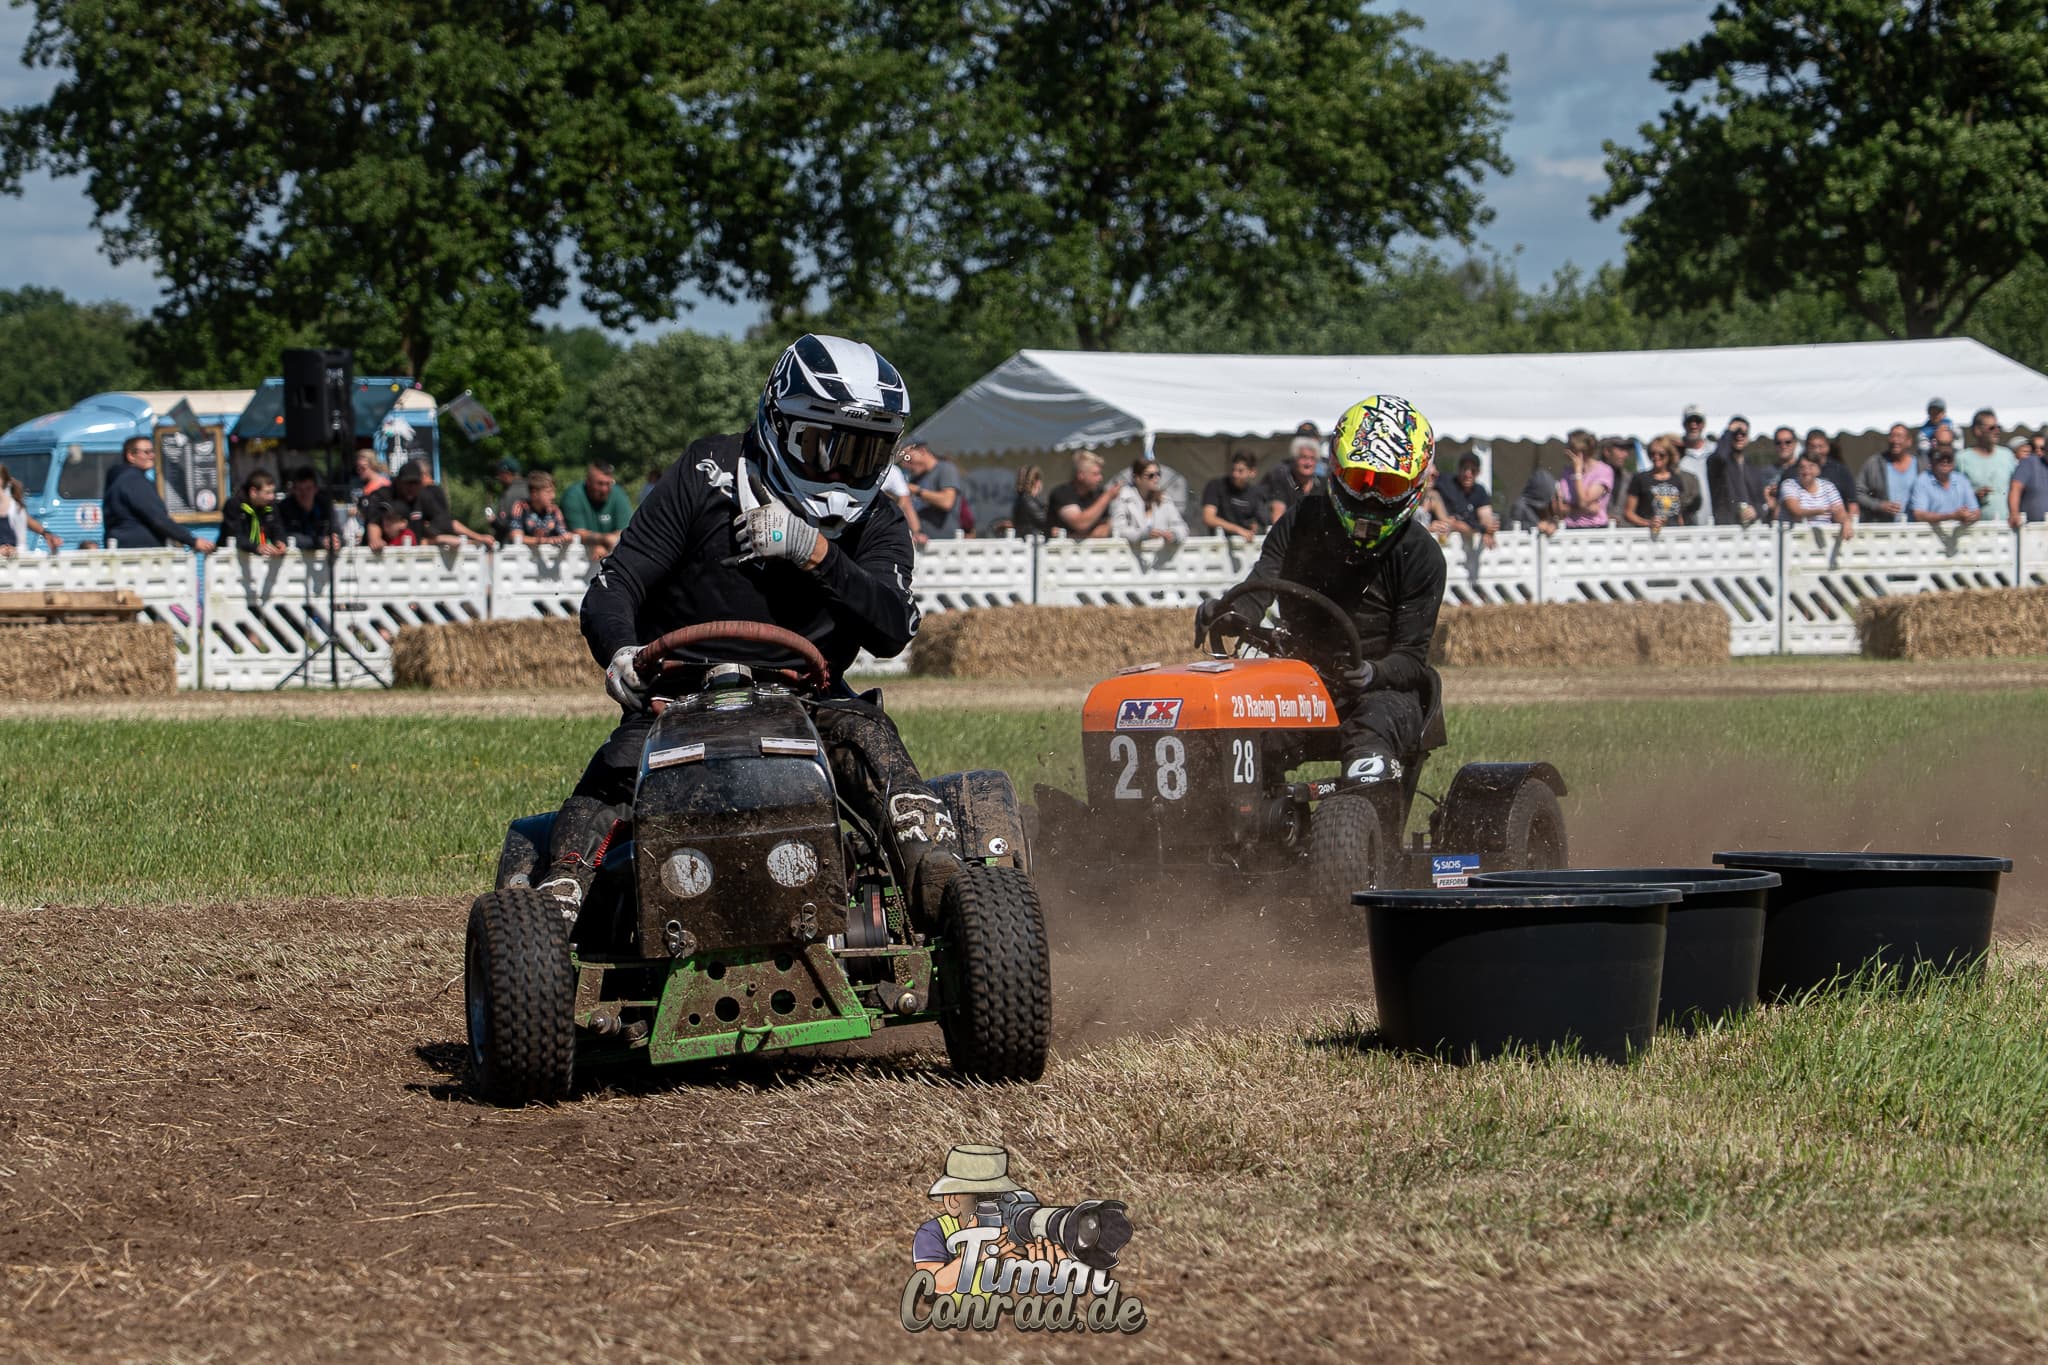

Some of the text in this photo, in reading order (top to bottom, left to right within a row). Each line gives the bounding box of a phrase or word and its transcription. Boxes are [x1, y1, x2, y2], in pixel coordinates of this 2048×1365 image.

[1120, 702, 1179, 720] NX
[1231, 694, 1327, 723] 28 Racing Team Big Boy
[1232, 739, 1255, 784] 28
